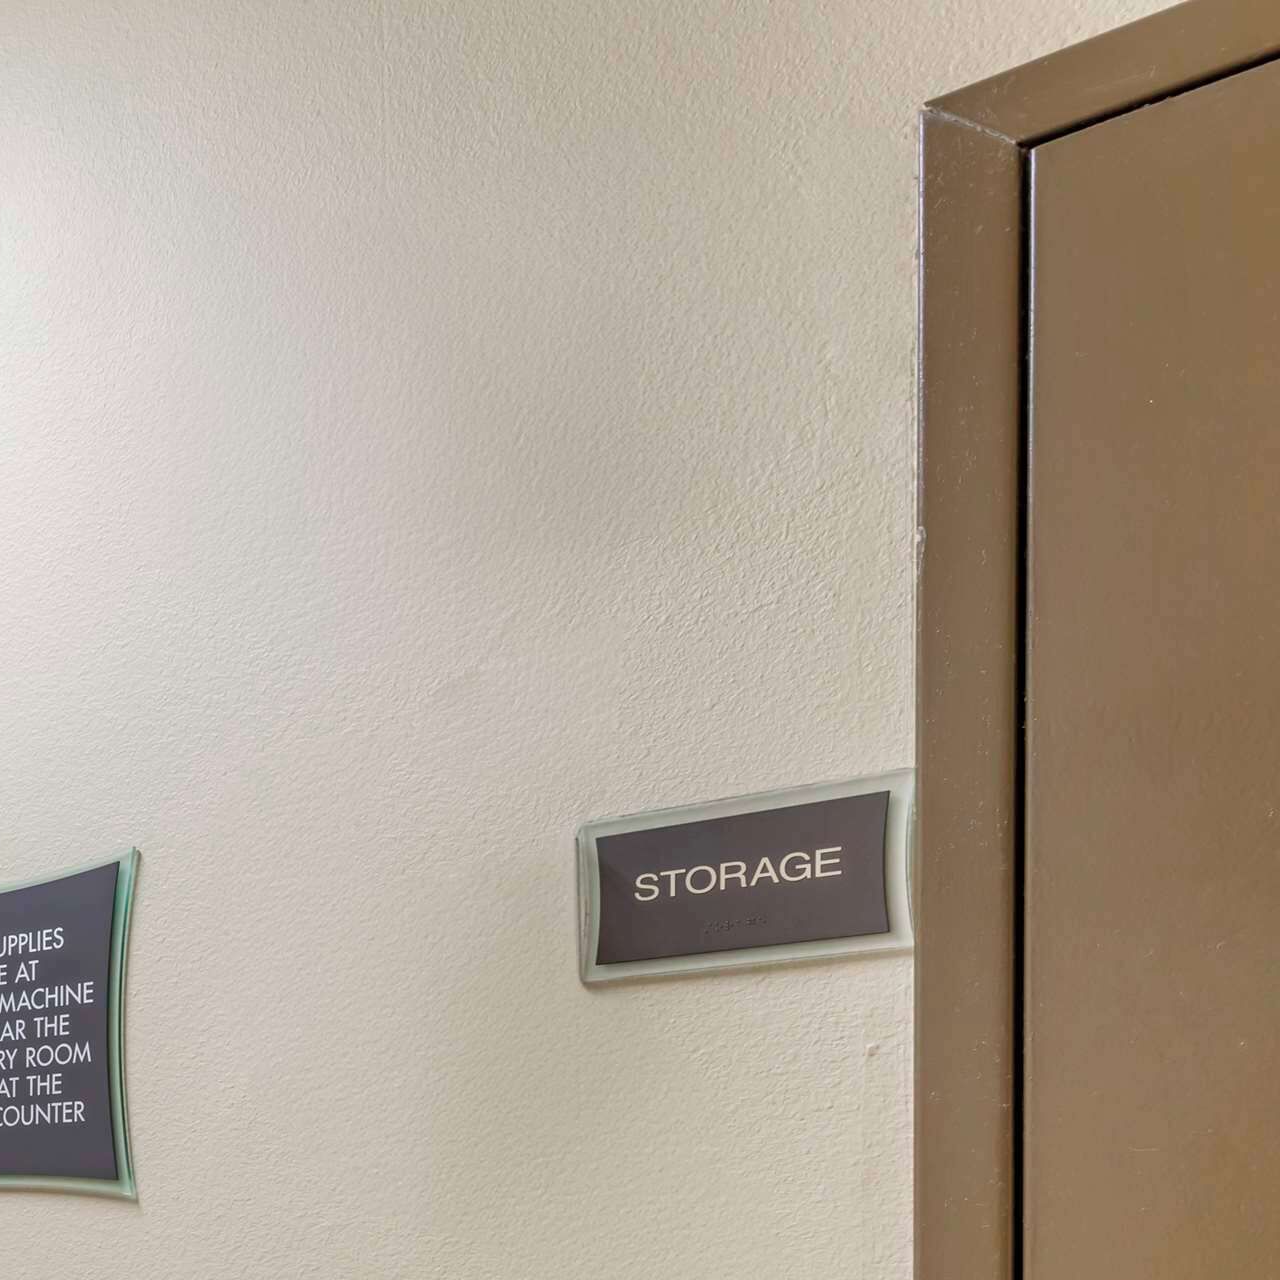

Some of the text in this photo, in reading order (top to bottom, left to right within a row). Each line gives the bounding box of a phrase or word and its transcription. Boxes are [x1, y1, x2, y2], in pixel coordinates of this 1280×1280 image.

[634, 846, 842, 902] STORAGE
[14, 959, 40, 984] AT
[33, 1013, 70, 1038] THE
[25, 1041, 92, 1068] ROOM
[25, 1072, 62, 1097] THE
